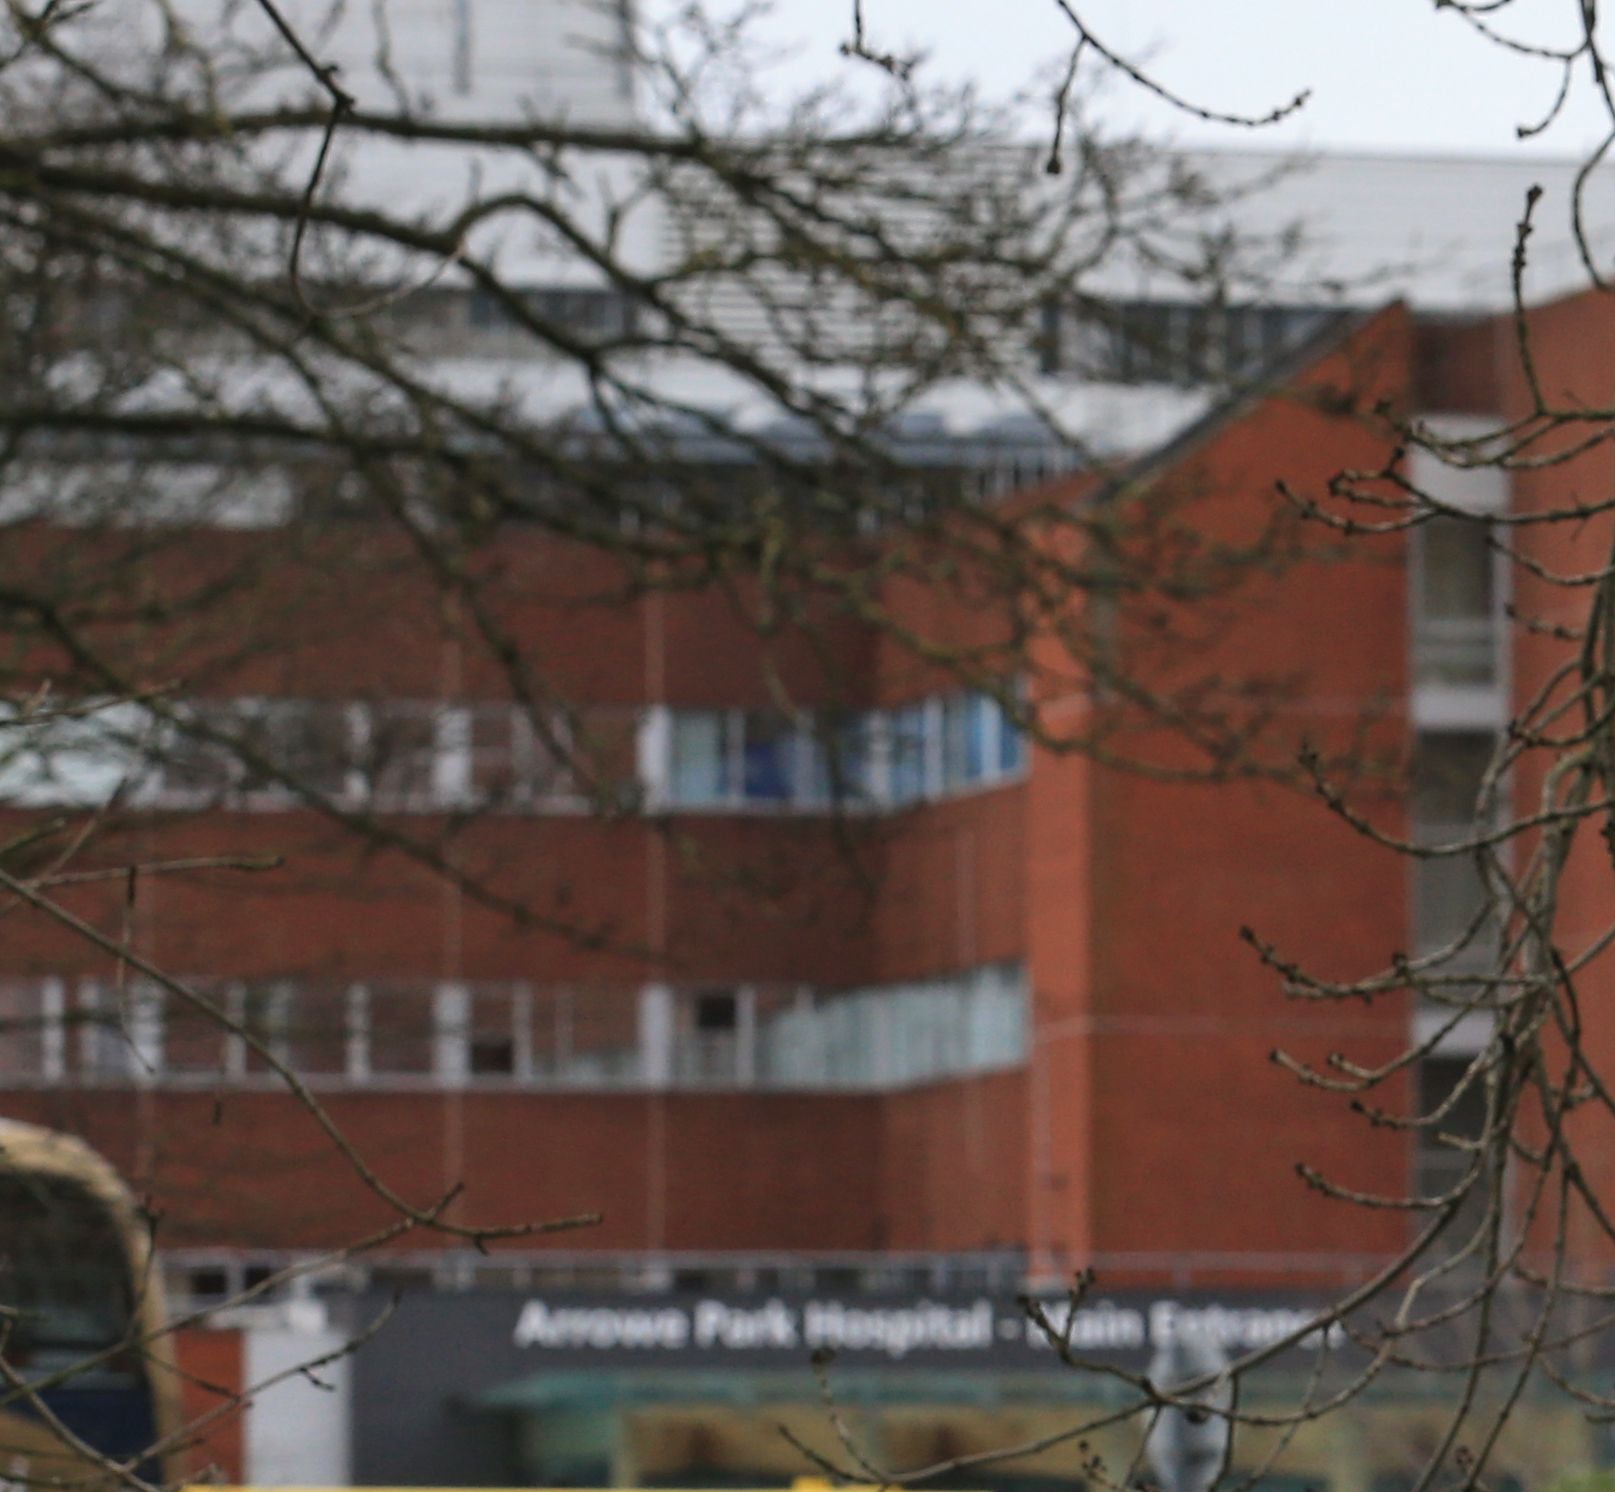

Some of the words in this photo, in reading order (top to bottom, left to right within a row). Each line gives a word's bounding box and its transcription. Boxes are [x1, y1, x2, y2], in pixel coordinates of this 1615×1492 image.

[514, 1300, 690, 1349] Arrowe
[695, 1300, 797, 1349] Park
[804, 1300, 993, 1357] Hospital
